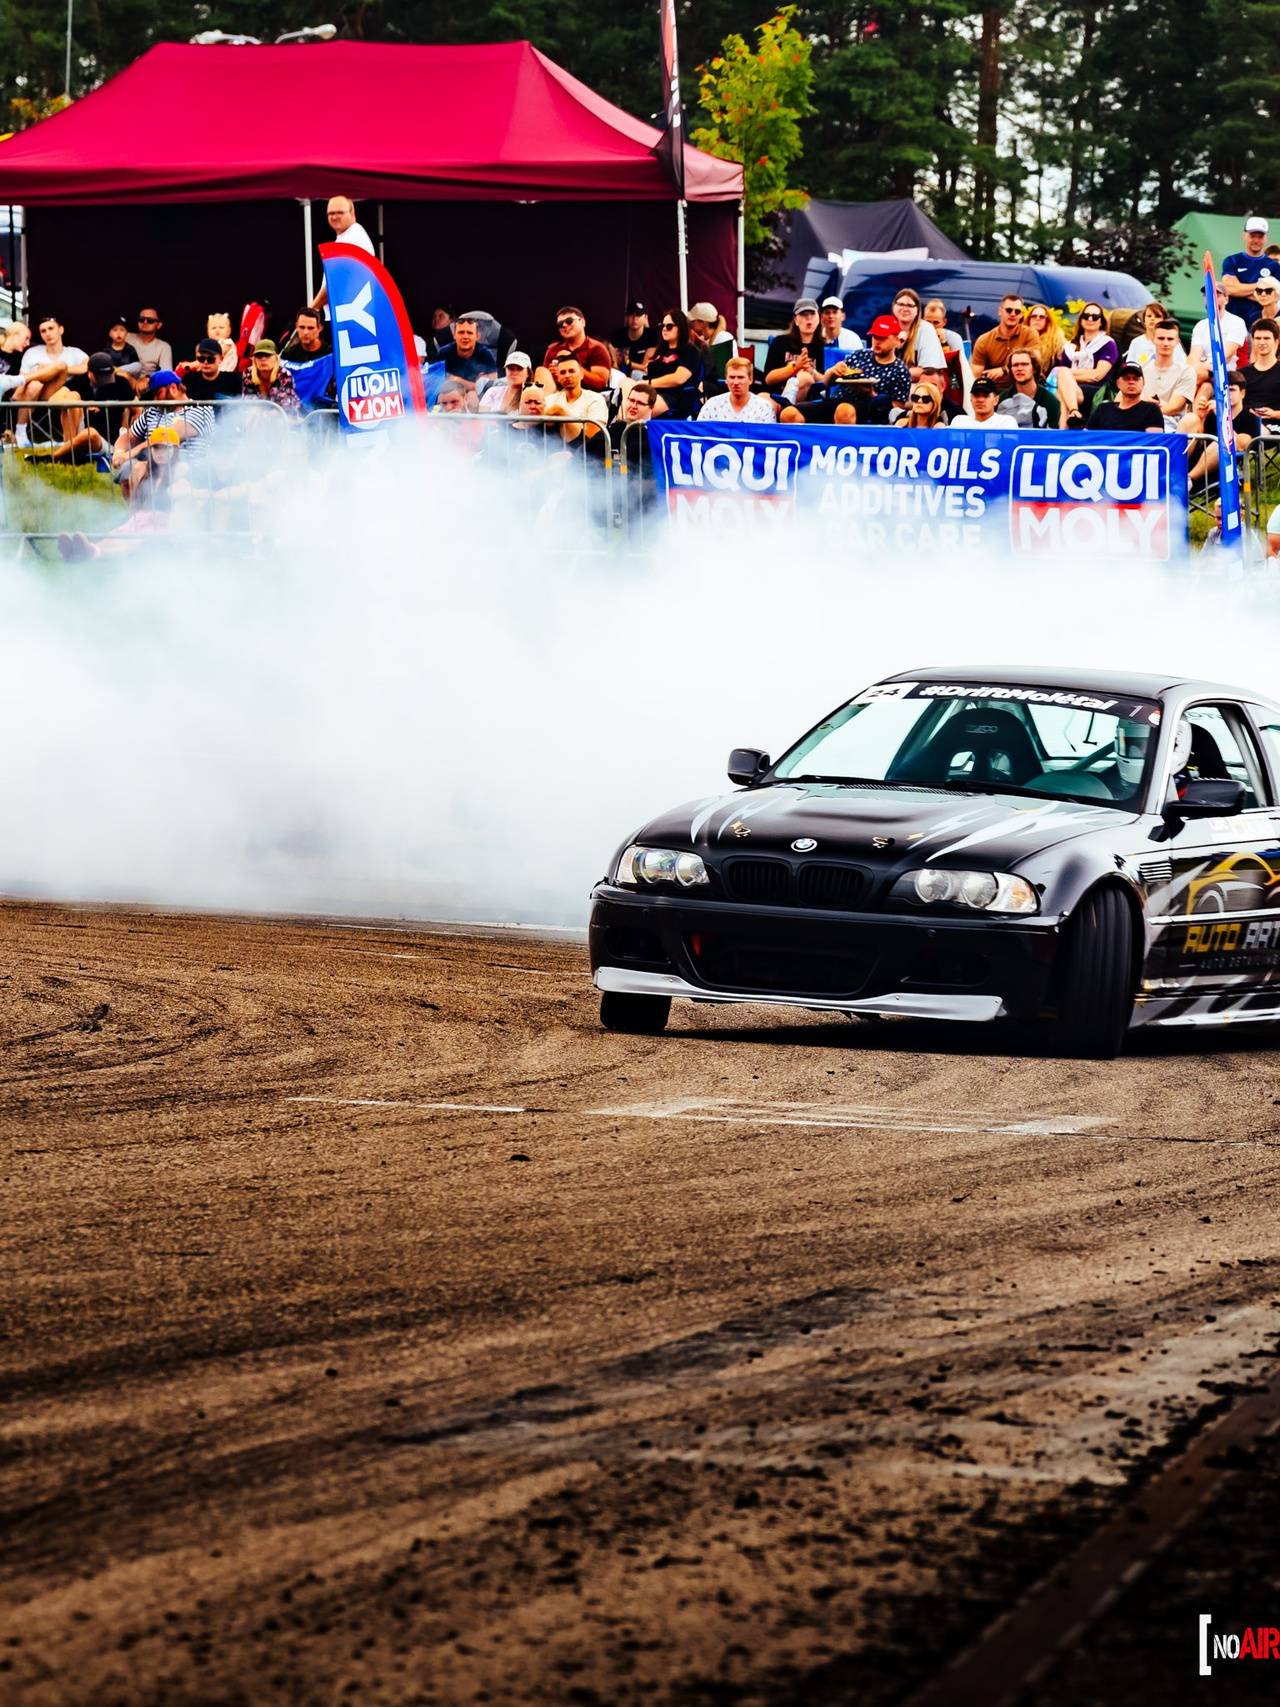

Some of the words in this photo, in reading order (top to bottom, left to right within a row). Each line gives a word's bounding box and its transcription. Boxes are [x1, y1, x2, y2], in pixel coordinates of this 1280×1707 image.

[670, 441, 792, 492] LIQUI
[809, 445, 920, 478] MOTOR
[926, 447, 1002, 480] OILS
[1019, 452, 1160, 503] LIQUI
[817, 483, 986, 518] ADDITIVES
[1019, 507, 1165, 556] MOLY
[1182, 921, 1242, 953] AUTO
